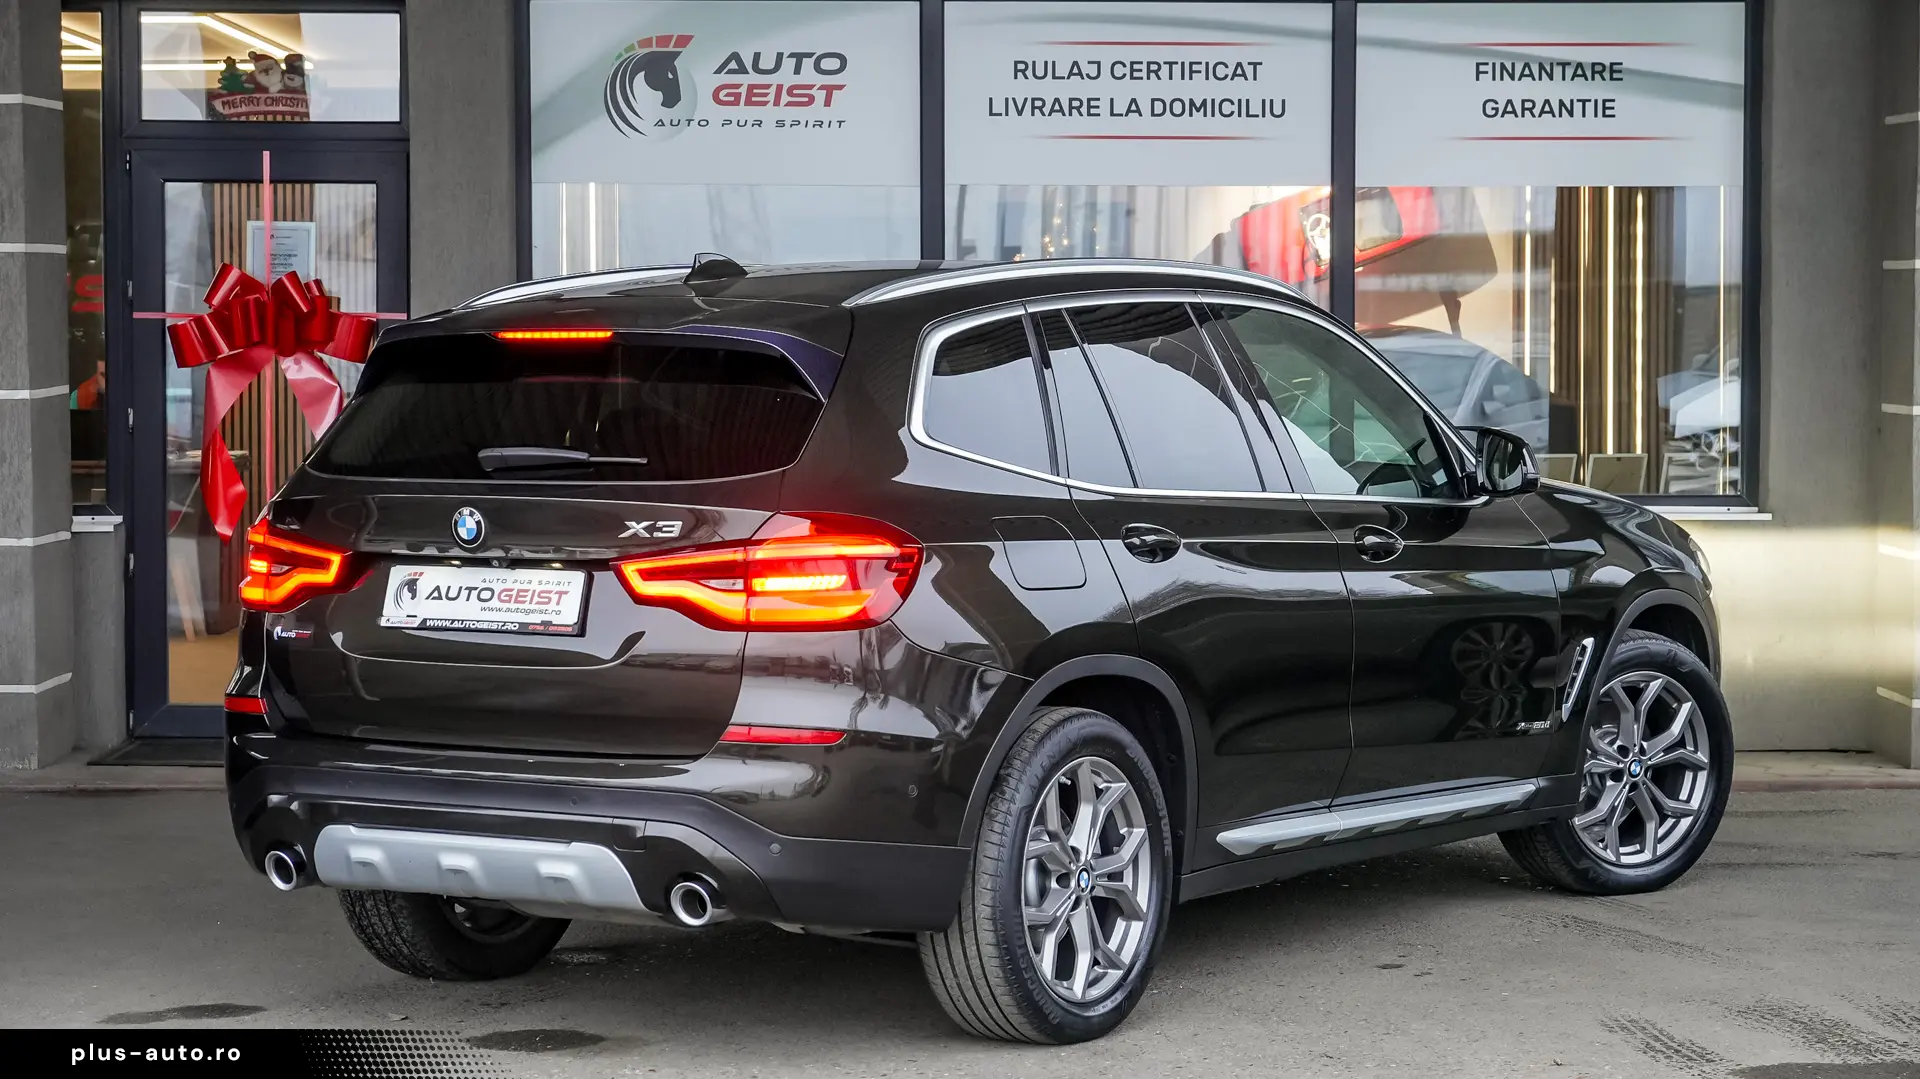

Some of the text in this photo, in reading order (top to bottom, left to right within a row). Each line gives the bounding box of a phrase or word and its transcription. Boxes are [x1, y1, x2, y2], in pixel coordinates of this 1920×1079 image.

[712, 51, 848, 76] AUTO
[1013, 60, 1263, 81] RULAJ CERTIFICAT
[1475, 62, 1624, 82] FINANTARE
[221, 96, 261, 111] MERRY
[712, 83, 847, 108] GEIST
[988, 97, 1287, 118] LIVRARE LA DOMICILIU
[1482, 98, 1616, 118] GARANTIE
[653, 118, 846, 129] AUTO PUR SPIRIT
[617, 520, 683, 538] X3
[480, 577, 508, 585] AUTO
[480, 605, 562, 616] www.autogeist.ro
[426, 619, 520, 631] WWW.AUTOGEIST.RO
